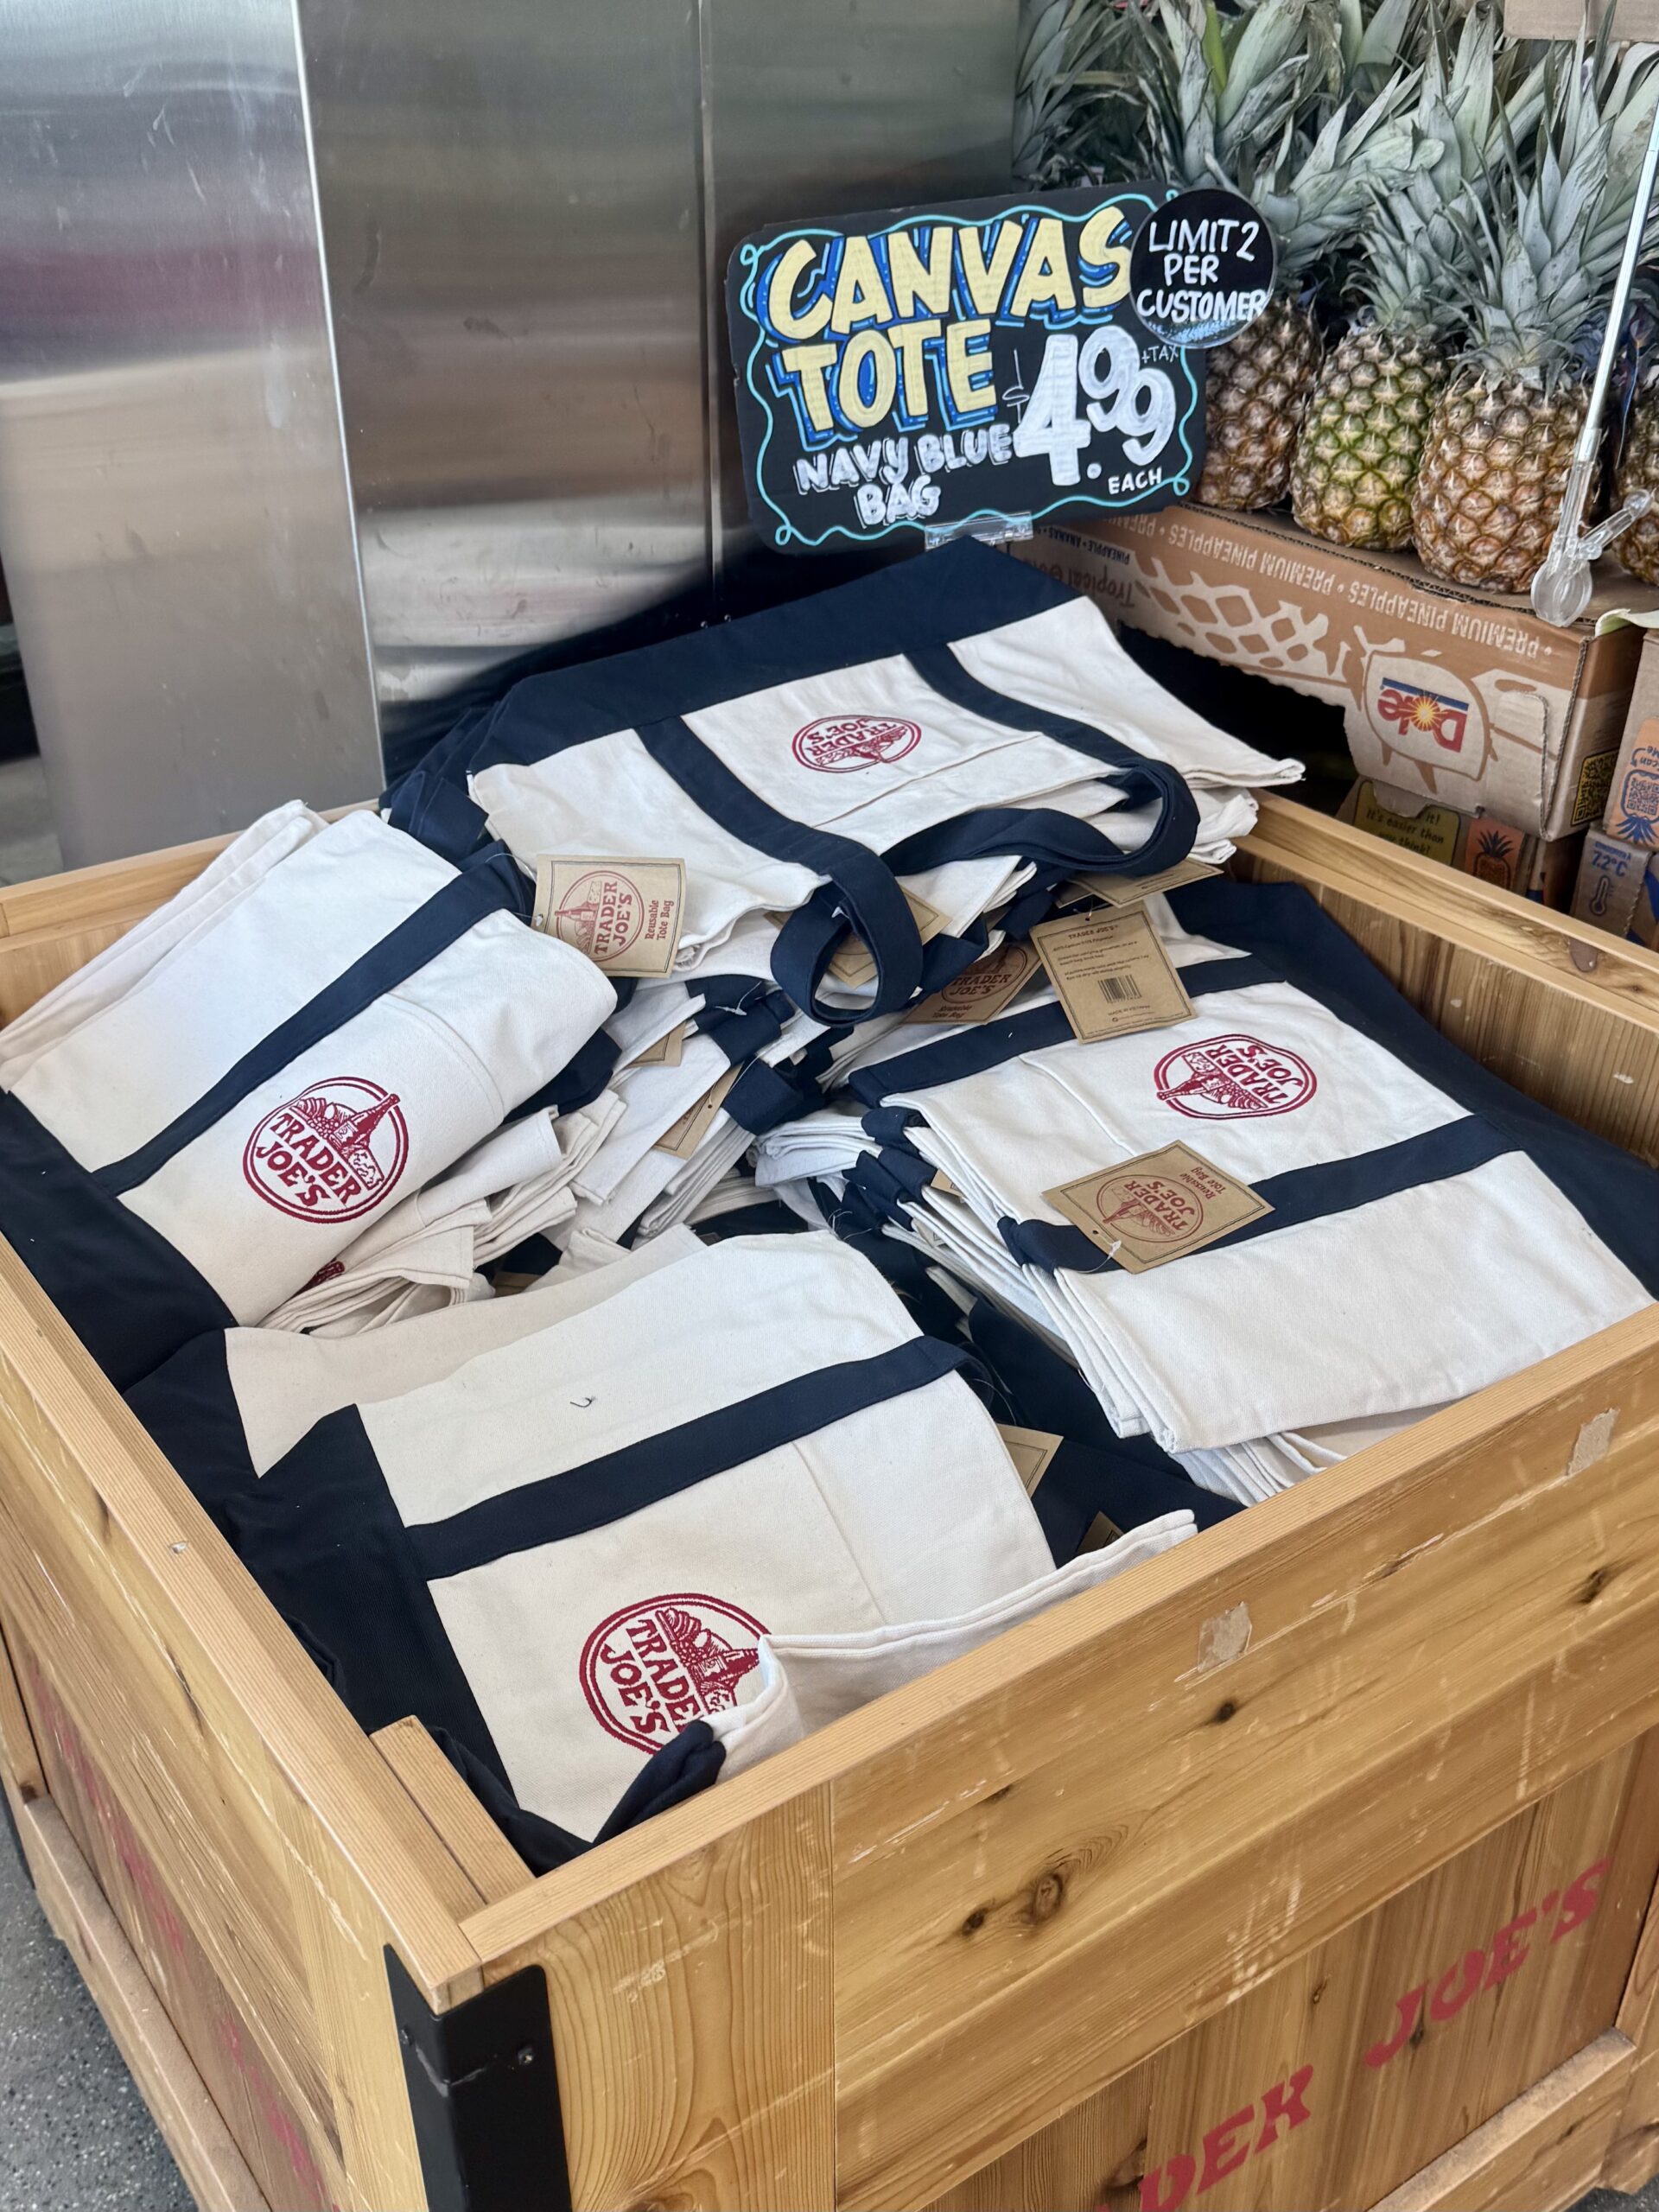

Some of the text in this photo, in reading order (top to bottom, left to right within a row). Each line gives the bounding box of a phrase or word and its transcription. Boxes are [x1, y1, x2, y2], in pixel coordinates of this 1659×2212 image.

[1149, 219, 1260, 262] LIMIT 2
[766, 207, 1131, 340] CANVAS
[1164, 253, 1220, 287] PER
[1136, 288, 1268, 323] CUSTOMER
[779, 319, 999, 432] TOTE
[793, 423, 1013, 495] NAVY BLUE
[1108, 467, 1162, 495] EACH
[854, 474, 941, 528] BAG
[1087, 540, 1130, 565] PINEAPPLE
[1168, 524, 1257, 569] PINEAPPLES
[1259, 552, 1335, 595] PREMIUM
[1348, 581, 1448, 632] PINEAPPLES
[1451, 613, 1541, 659] PREMIUM
[804, 722, 897, 757] TRADER
[807, 717, 871, 745] JOE'S
[1377, 689, 1467, 753] Dole
[1640, 756, 1659, 772] can
[594, 880, 618, 955] TRADER
[613, 892, 632, 947] JOE'S
[644, 899, 659, 941] Reusable
[657, 899, 675, 941] Tote Bag
[951, 974, 1012, 987] TRADER
[953, 984, 996, 995] JOE'S
[1205, 1045, 1288, 1103] TRADER
[1236, 1045, 1304, 1088] JOE'S
[256, 1141, 332, 1206] JOE'S
[270, 1112, 362, 1205] TRADER
[1191, 1166, 1226, 1194] Tote Bag
[1124, 1180, 1188, 1231] TRADER
[1146, 1180, 1195, 1217] JOE'S
[1179, 1173, 1216, 1199] Reusable
[600, 1643, 671, 1734] JOE'S
[626, 1619, 704, 1733] TRADE
[1095, 1856, 1614, 2212] DER JOE'S
